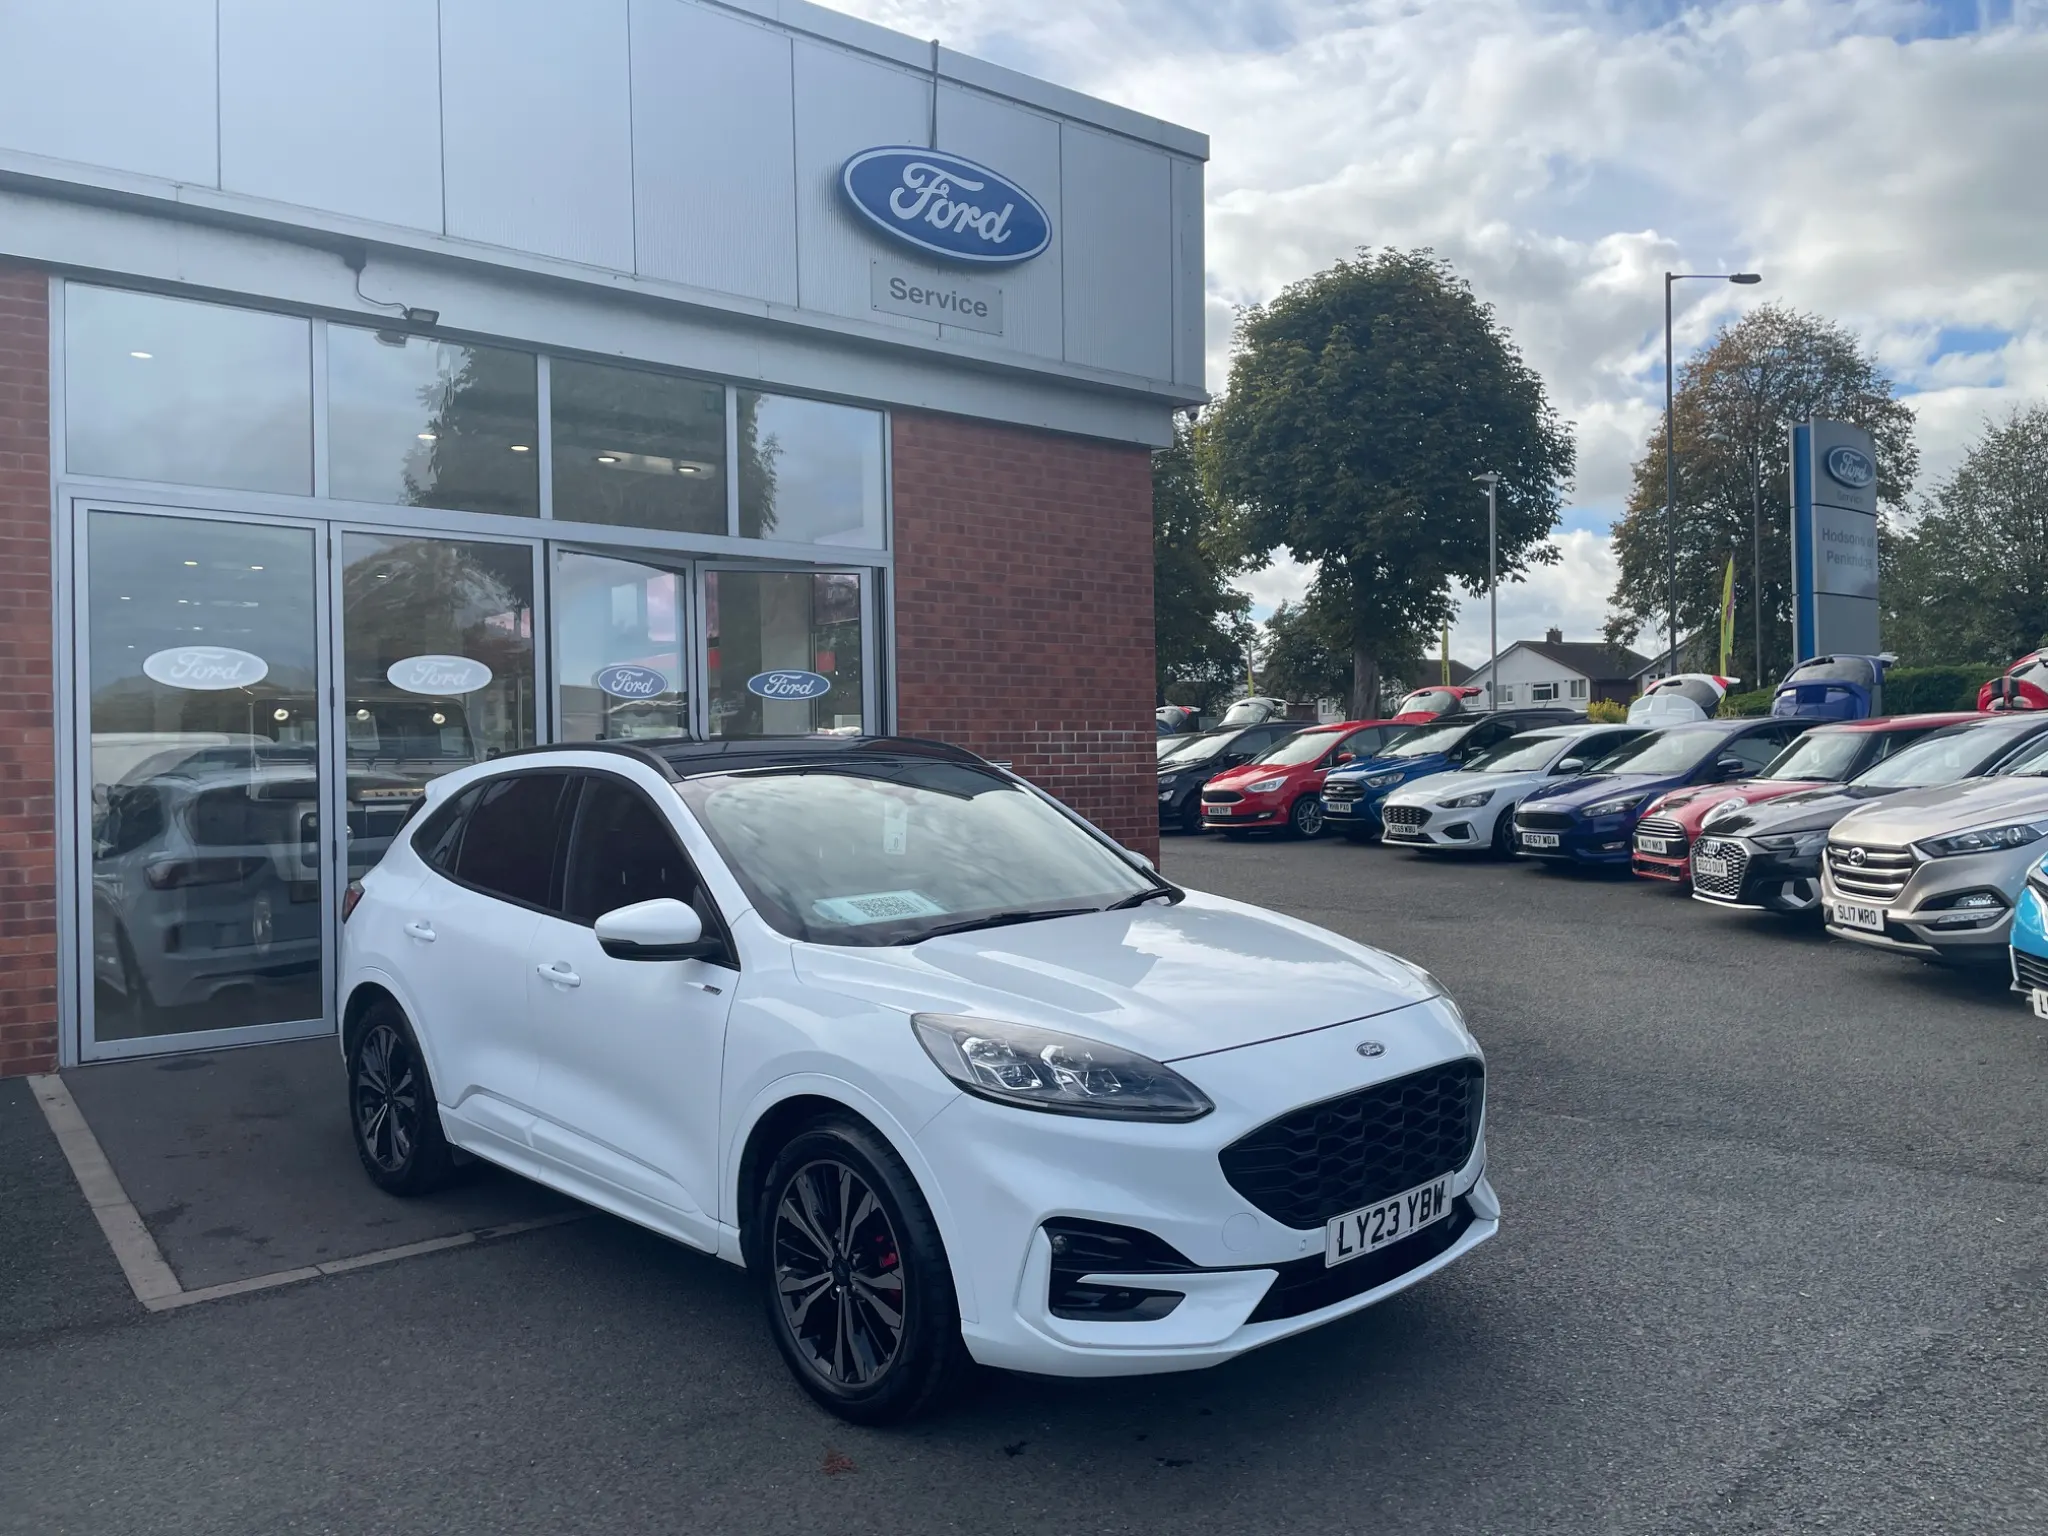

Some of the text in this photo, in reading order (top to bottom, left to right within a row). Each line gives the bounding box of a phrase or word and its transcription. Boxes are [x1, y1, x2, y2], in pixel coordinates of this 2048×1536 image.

[889, 162, 1015, 244] Ford
[889, 276, 989, 318] Service
[1839, 451, 1868, 481] Ford
[1822, 527, 1866, 547] Hodsons
[169, 652, 243, 681] Ford
[409, 662, 470, 687] Ford
[611, 669, 654, 695] Ford
[763, 673, 815, 696] Ford
[1838, 905, 1856, 922] SL17
[1337, 1180, 1446, 1257] LY23 YBW
